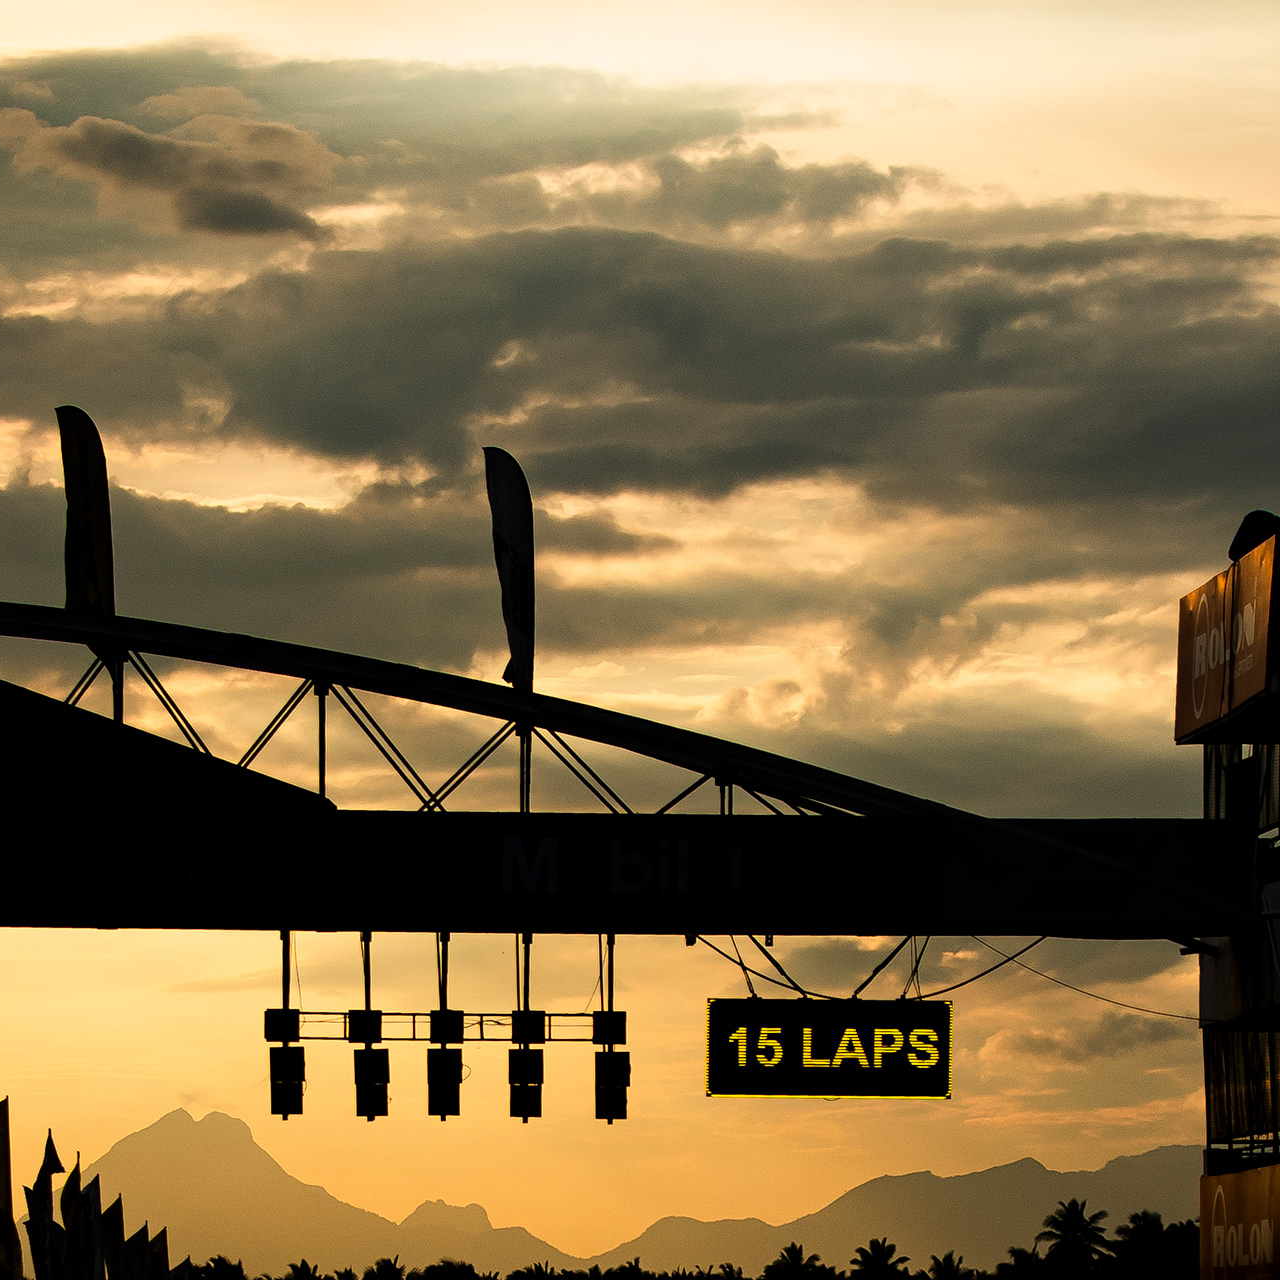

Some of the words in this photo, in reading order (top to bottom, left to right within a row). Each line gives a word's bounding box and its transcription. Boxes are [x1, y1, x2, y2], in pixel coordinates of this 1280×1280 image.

[501, 836, 691, 895] Mbil
[728, 1027, 784, 1068] 15
[802, 1027, 940, 1069] LAPS
[1213, 1218, 1275, 1268] ROLON
